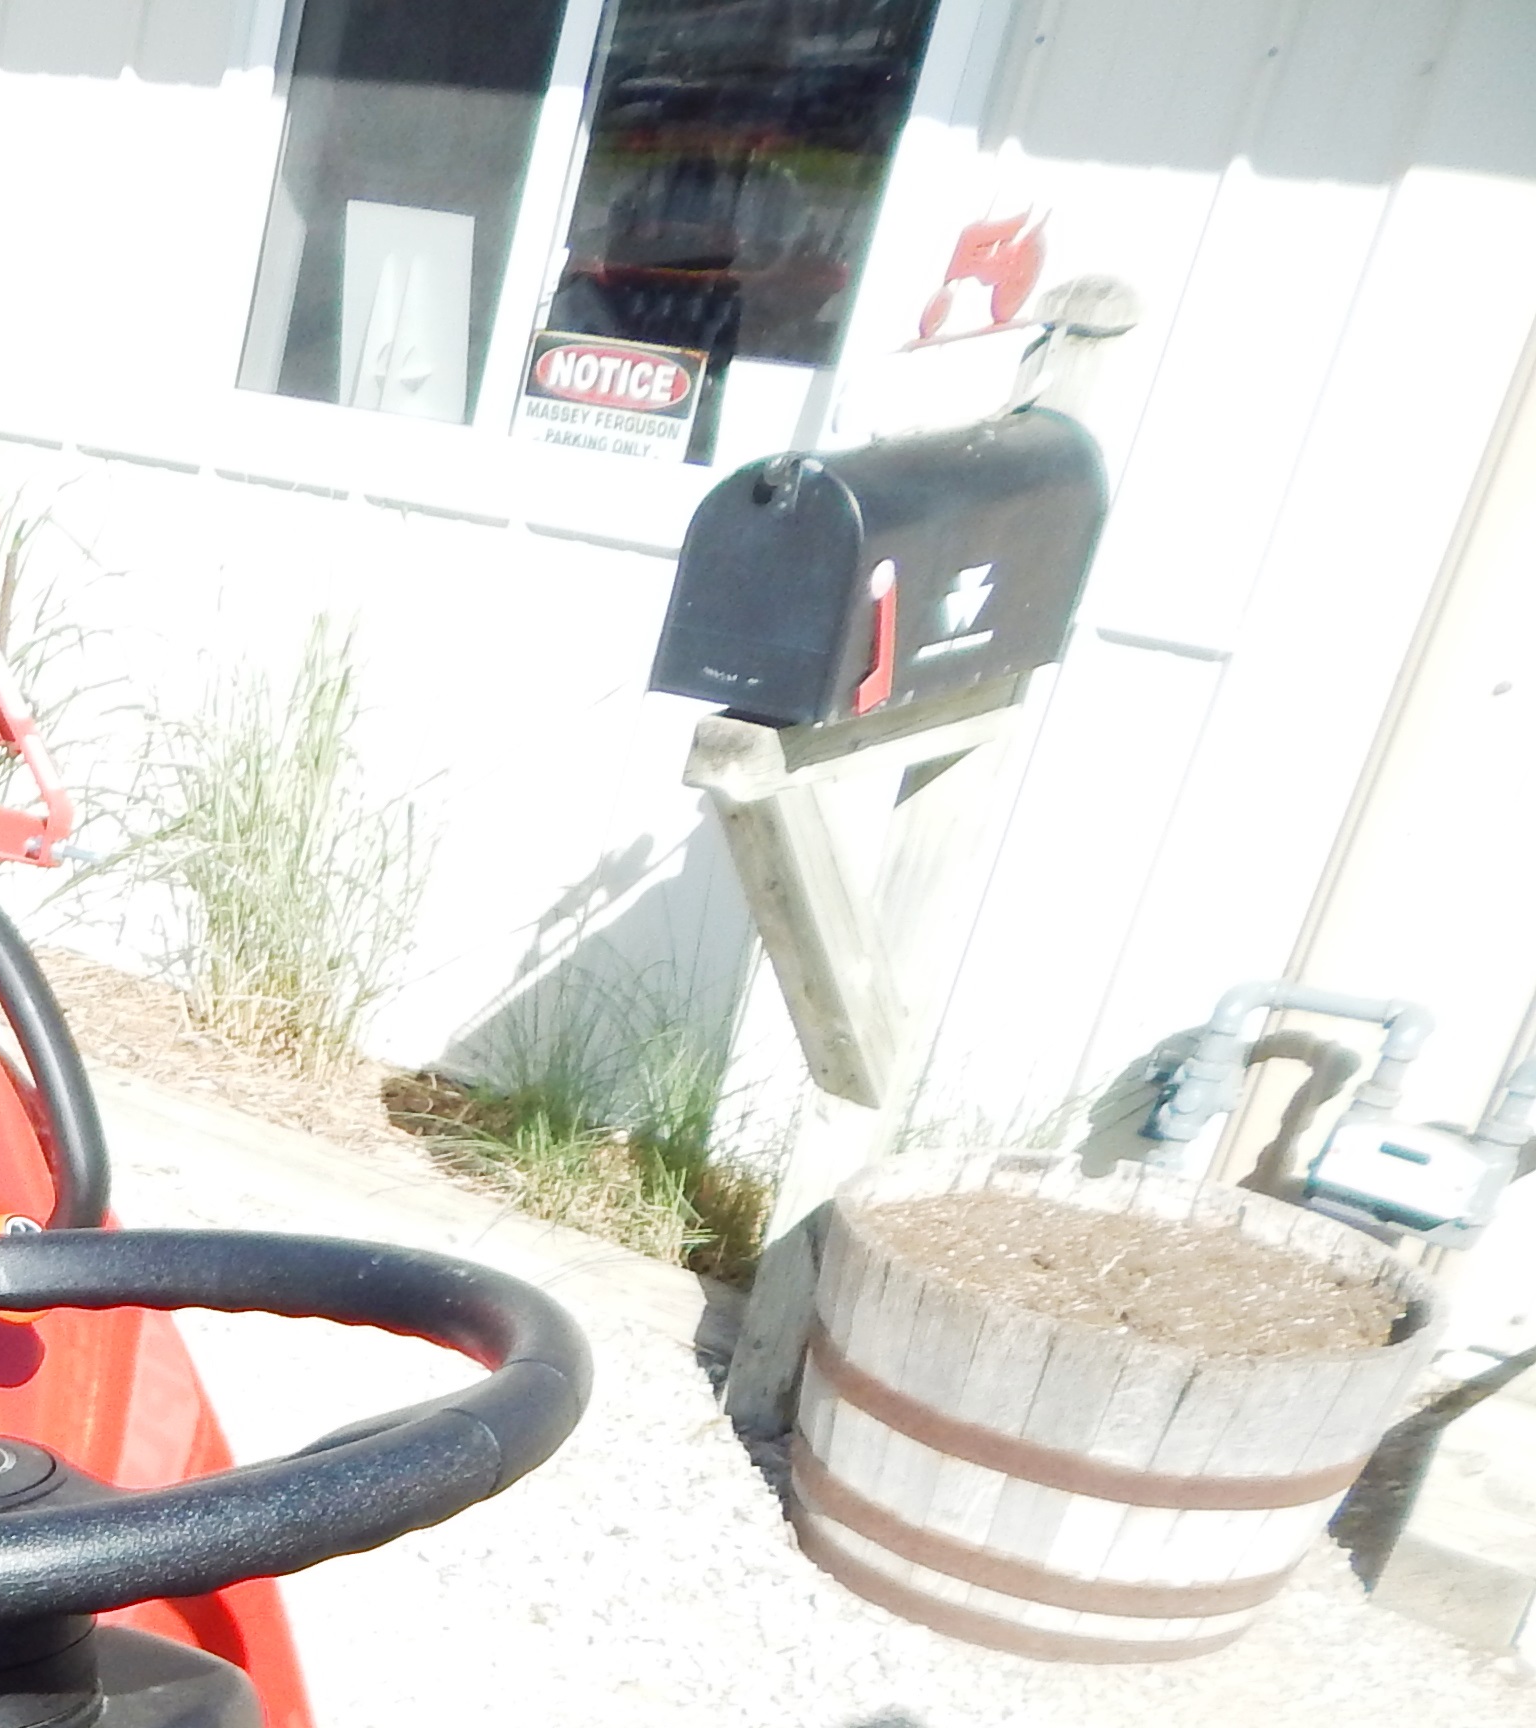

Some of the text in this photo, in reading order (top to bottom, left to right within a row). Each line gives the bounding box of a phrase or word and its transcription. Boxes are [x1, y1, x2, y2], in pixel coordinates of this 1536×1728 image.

[548, 350, 678, 402] NOTICE
[525, 401, 682, 441] MASSEY FERGUSON
[544, 427, 652, 459] PARKING ONLY
